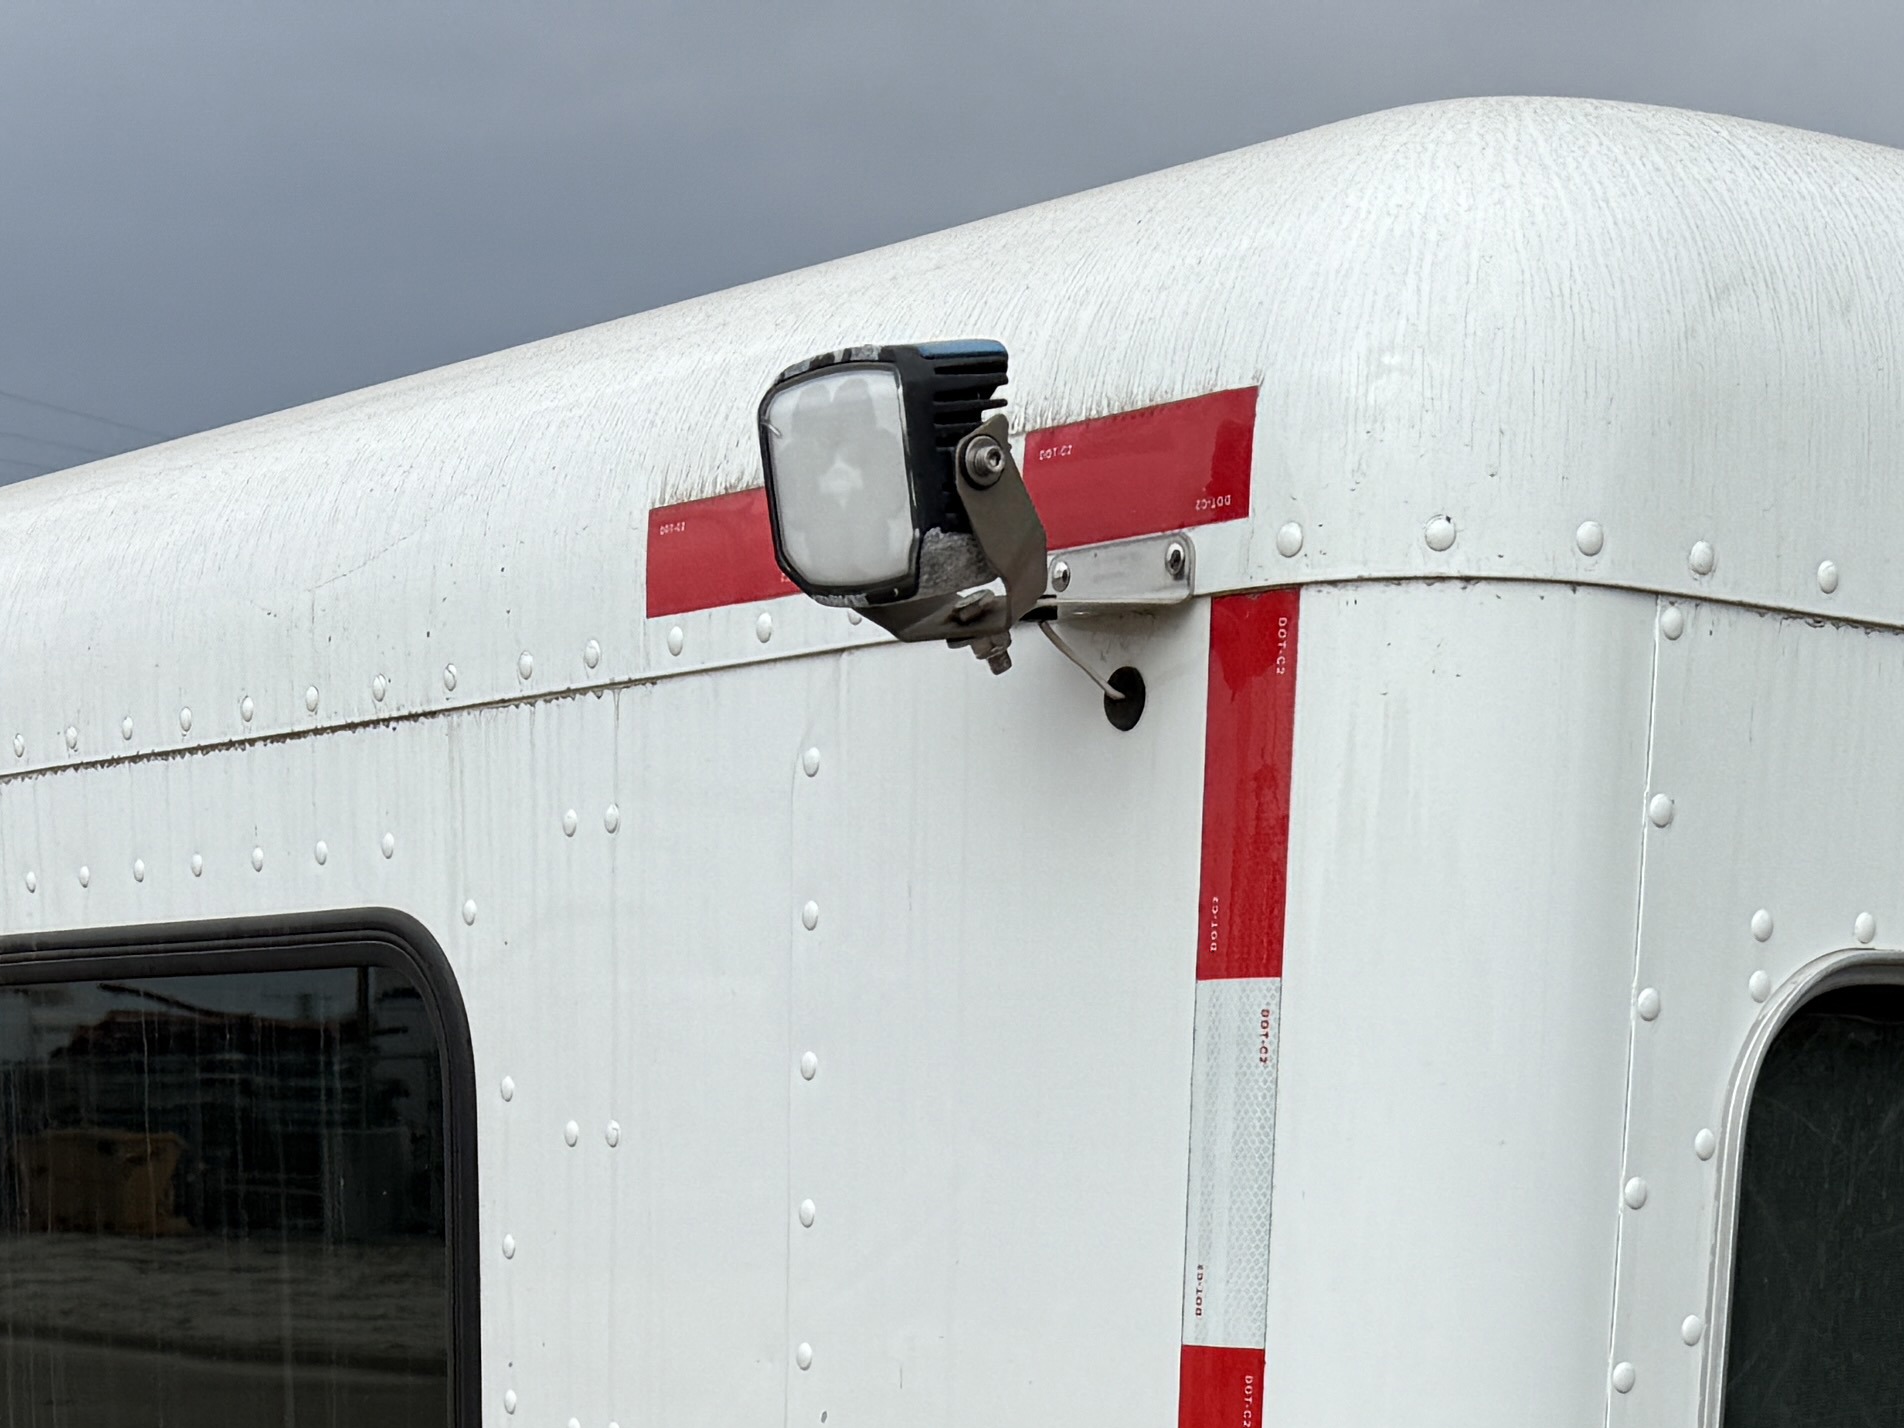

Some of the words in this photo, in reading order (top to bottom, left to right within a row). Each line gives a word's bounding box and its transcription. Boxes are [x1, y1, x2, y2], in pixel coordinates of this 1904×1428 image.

[1039, 444, 1073, 461] DOT-C2
[1195, 495, 1231, 511] DOT-C2
[1275, 616, 1288, 676] DOT-C2
[1208, 895, 1220, 953] DOT-C2
[1259, 1008, 1271, 1064] DOT-C2
[1243, 1375, 1254, 1428] DOT-C2
